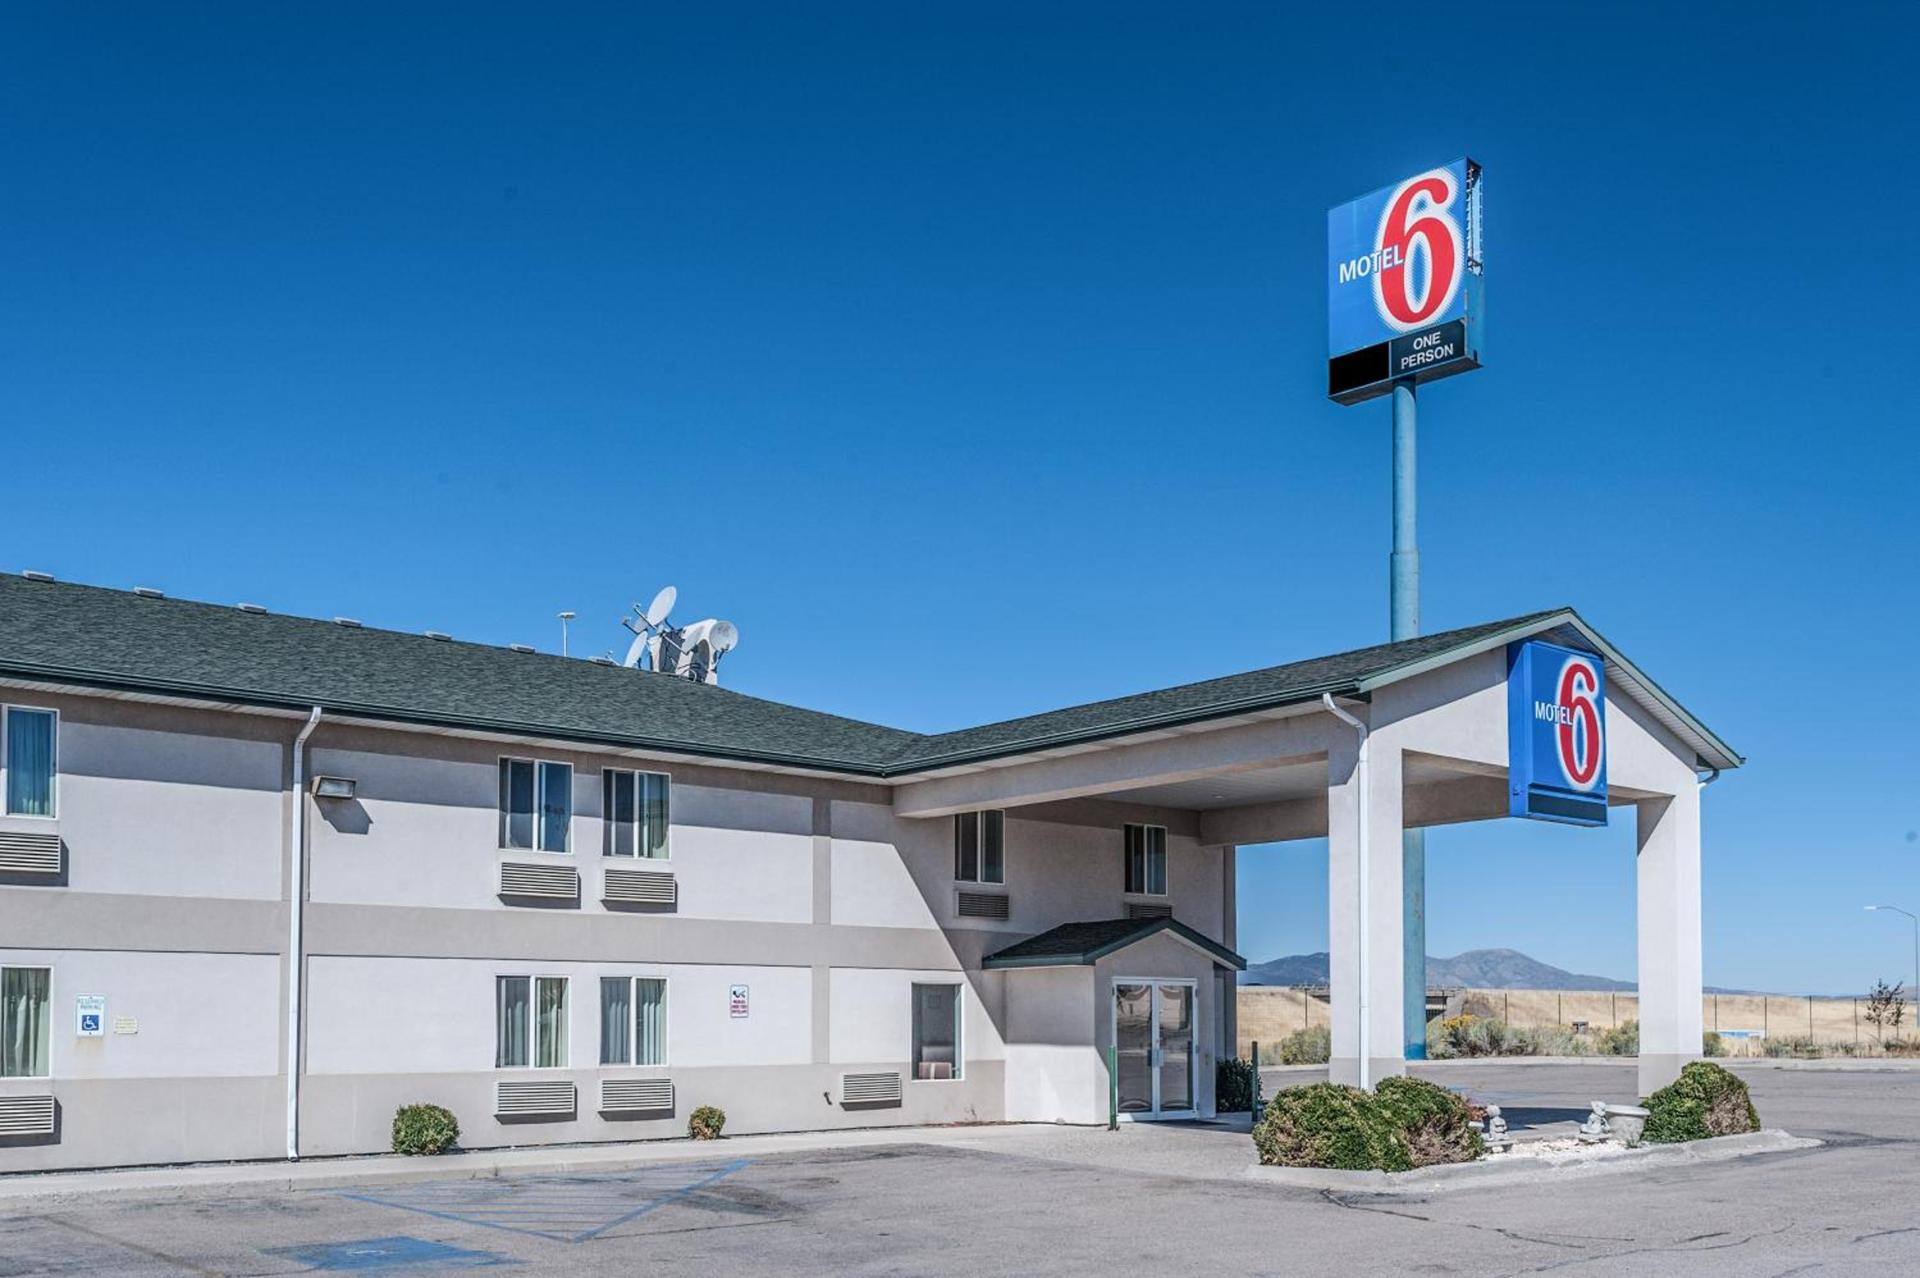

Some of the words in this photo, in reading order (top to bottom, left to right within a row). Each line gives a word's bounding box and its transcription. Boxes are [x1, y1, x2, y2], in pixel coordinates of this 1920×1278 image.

[1339, 244, 1405, 284] MOTEL
[1379, 175, 1457, 326] 6
[1400, 343, 1454, 370] PERSON
[1412, 331, 1441, 351] ONE
[1535, 700, 1573, 726] MOTEL
[1557, 662, 1600, 785] 6
